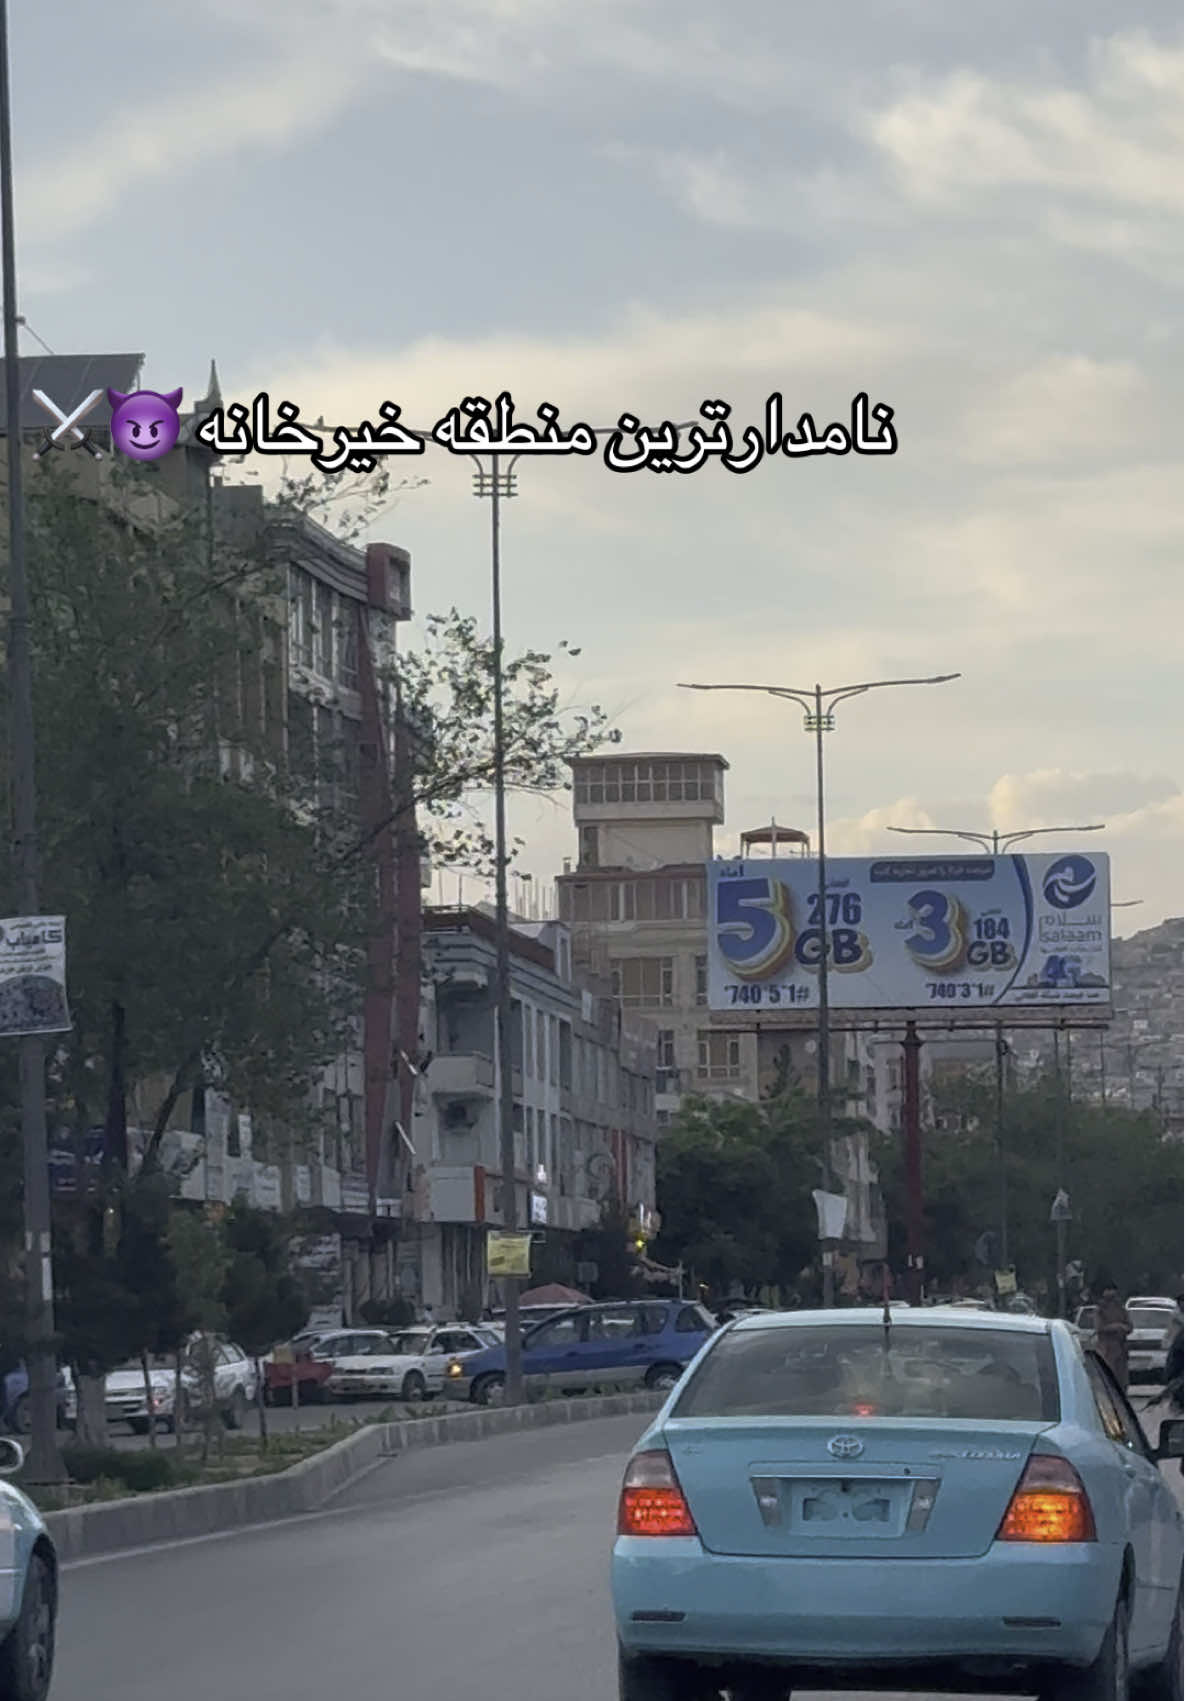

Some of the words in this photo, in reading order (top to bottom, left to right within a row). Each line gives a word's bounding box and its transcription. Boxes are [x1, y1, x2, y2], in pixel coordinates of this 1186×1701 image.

[717, 877, 784, 970] 5
[806, 892, 862, 925] 276
[904, 890, 958, 962] 3
[974, 917, 1010, 939] 184
[795, 928, 867, 968] GB
[967, 940, 1013, 967] GB
